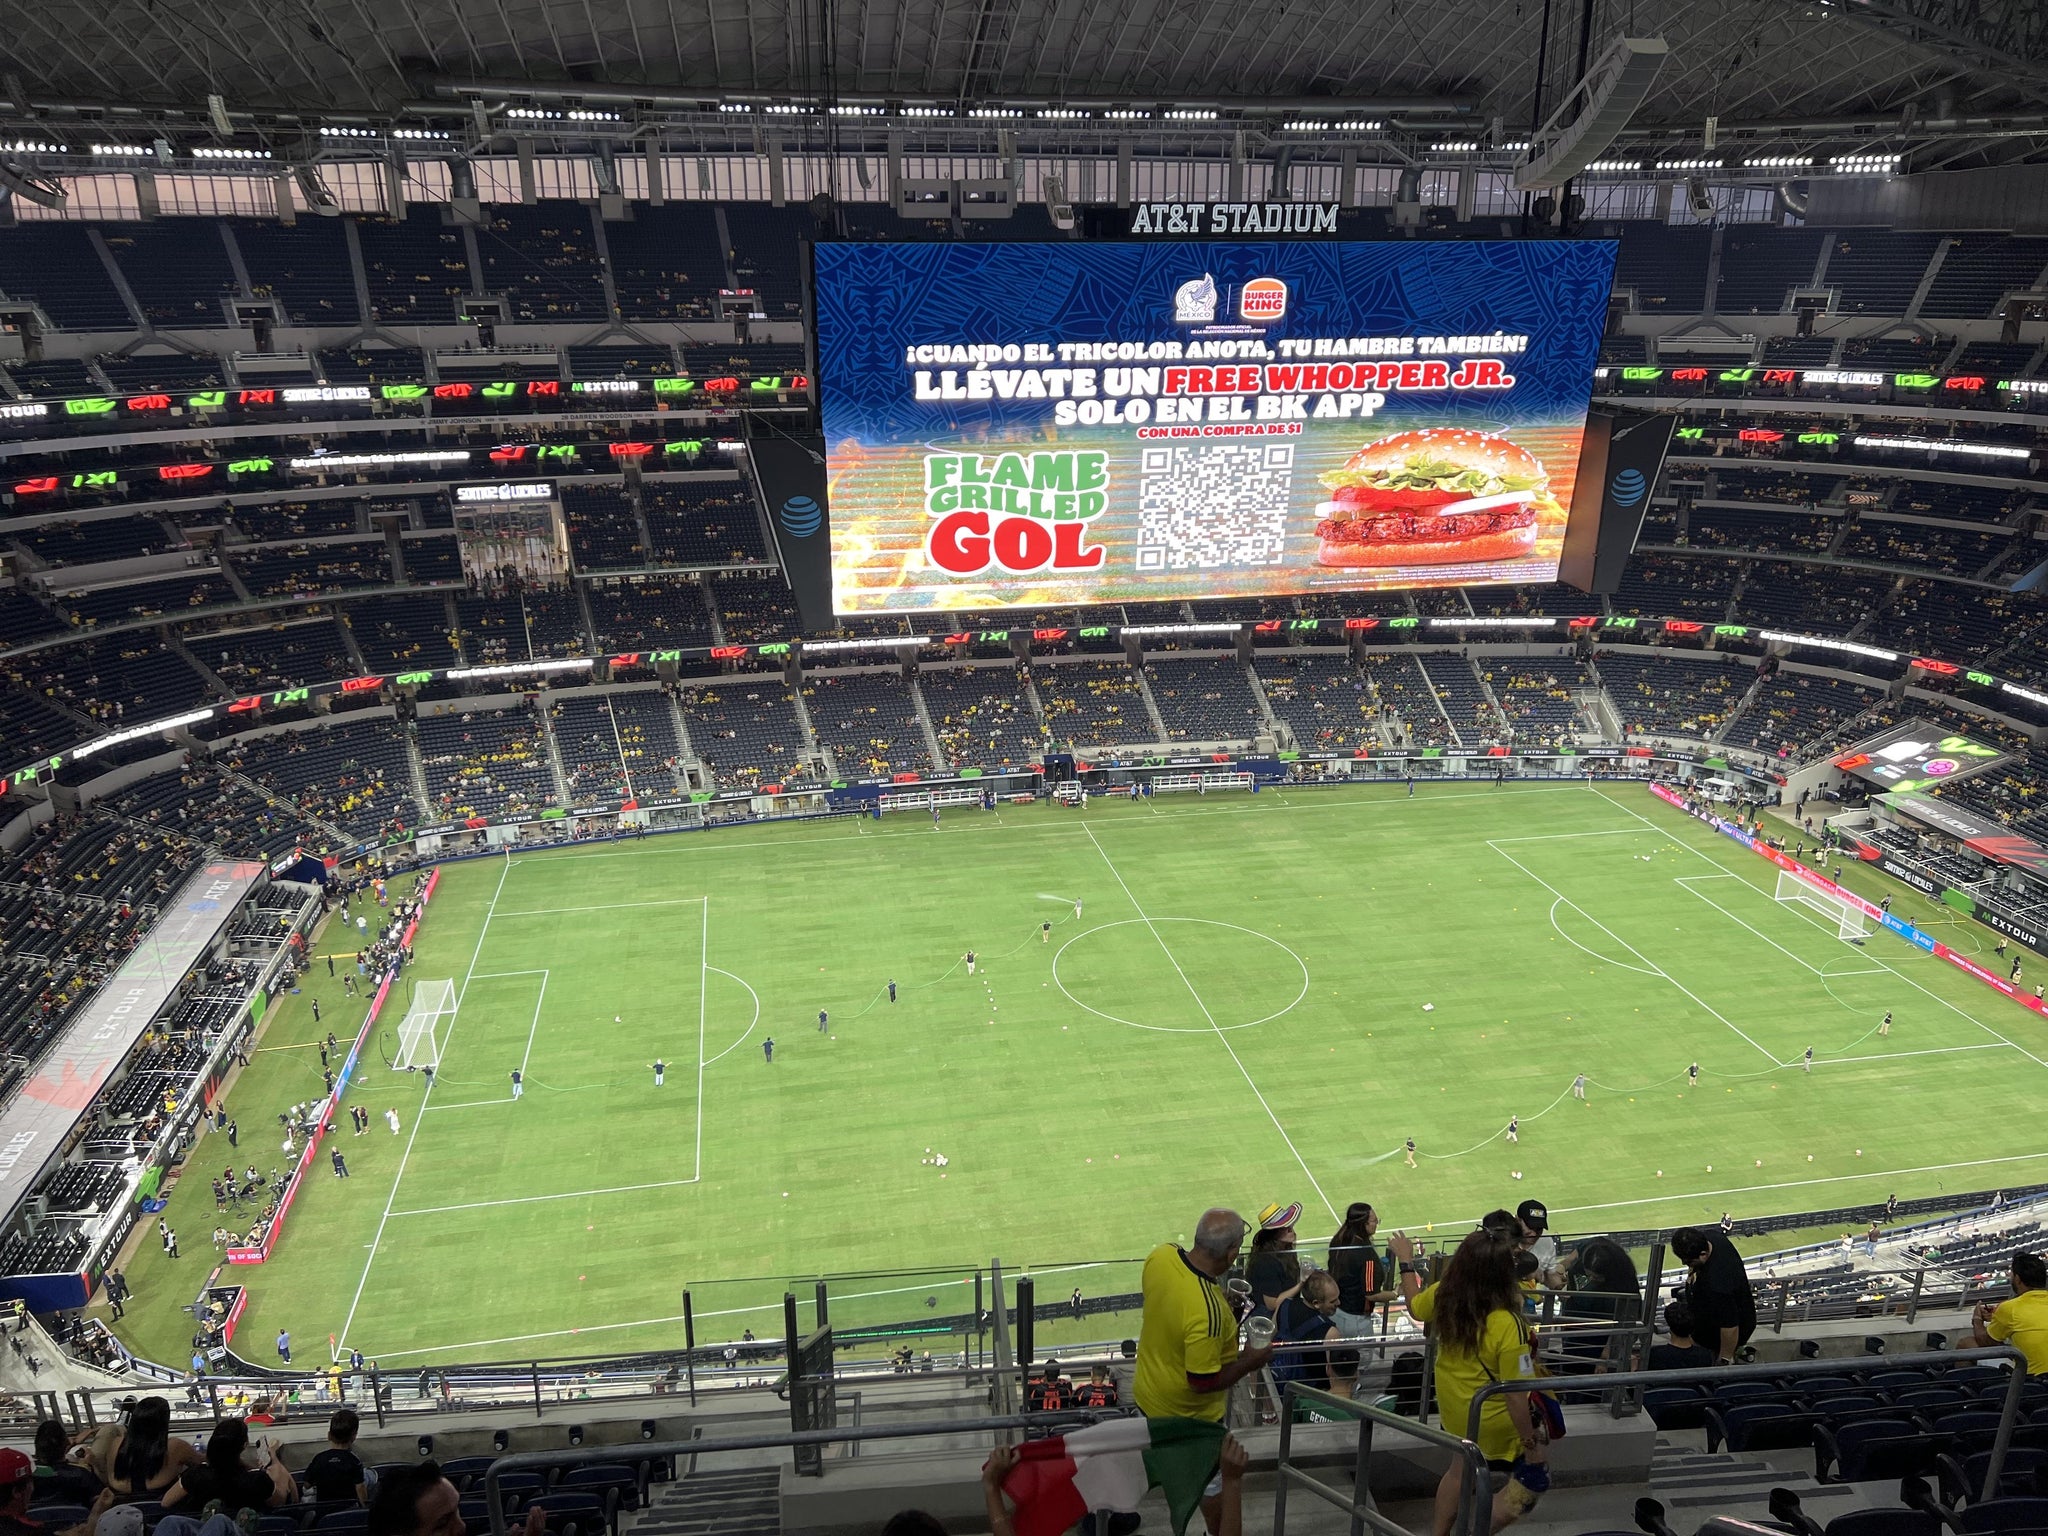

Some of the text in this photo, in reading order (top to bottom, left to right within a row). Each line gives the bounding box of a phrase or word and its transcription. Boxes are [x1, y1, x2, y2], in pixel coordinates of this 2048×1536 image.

[1131, 204, 1339, 233] AT&T STADIUM
[1244, 291, 1283, 300] BURGER
[1244, 299, 1283, 311] KING
[906, 331, 1528, 363] ¡CUANDO EL TRICOLOR ANOTA, TU HAMBRE TAMBIÉN!
[571, 381, 639, 392] MEXTOUR
[914, 361, 1514, 400] LLÉVATE UN FREE WHOPPER JR.
[0, 404, 47, 418] TOUR
[1054, 392, 1385, 426] SOLO EN EL BK APP
[1138, 423, 1301, 438] CON UNA COMPRA DE $1
[929, 453, 1106, 492] FLAME
[930, 484, 1105, 520] GRILLED
[930, 511, 1103, 572] GOL
[1006, 766, 1021, 774] AT&T
[1751, 770, 1765, 779] AT&T
[365, 841, 379, 851] AT&T
[202, 880, 233, 900] AT&T
[1836, 887, 1882, 919] BURGER KING
[1890, 919, 1903, 931] AT&T
[1981, 911, 2037, 946] MEXTOUR
[1918, 934, 1932, 947] AT&T
[86, 988, 146, 1047] EXTOUR
[94, 1212, 133, 1279] MEXTOUR
